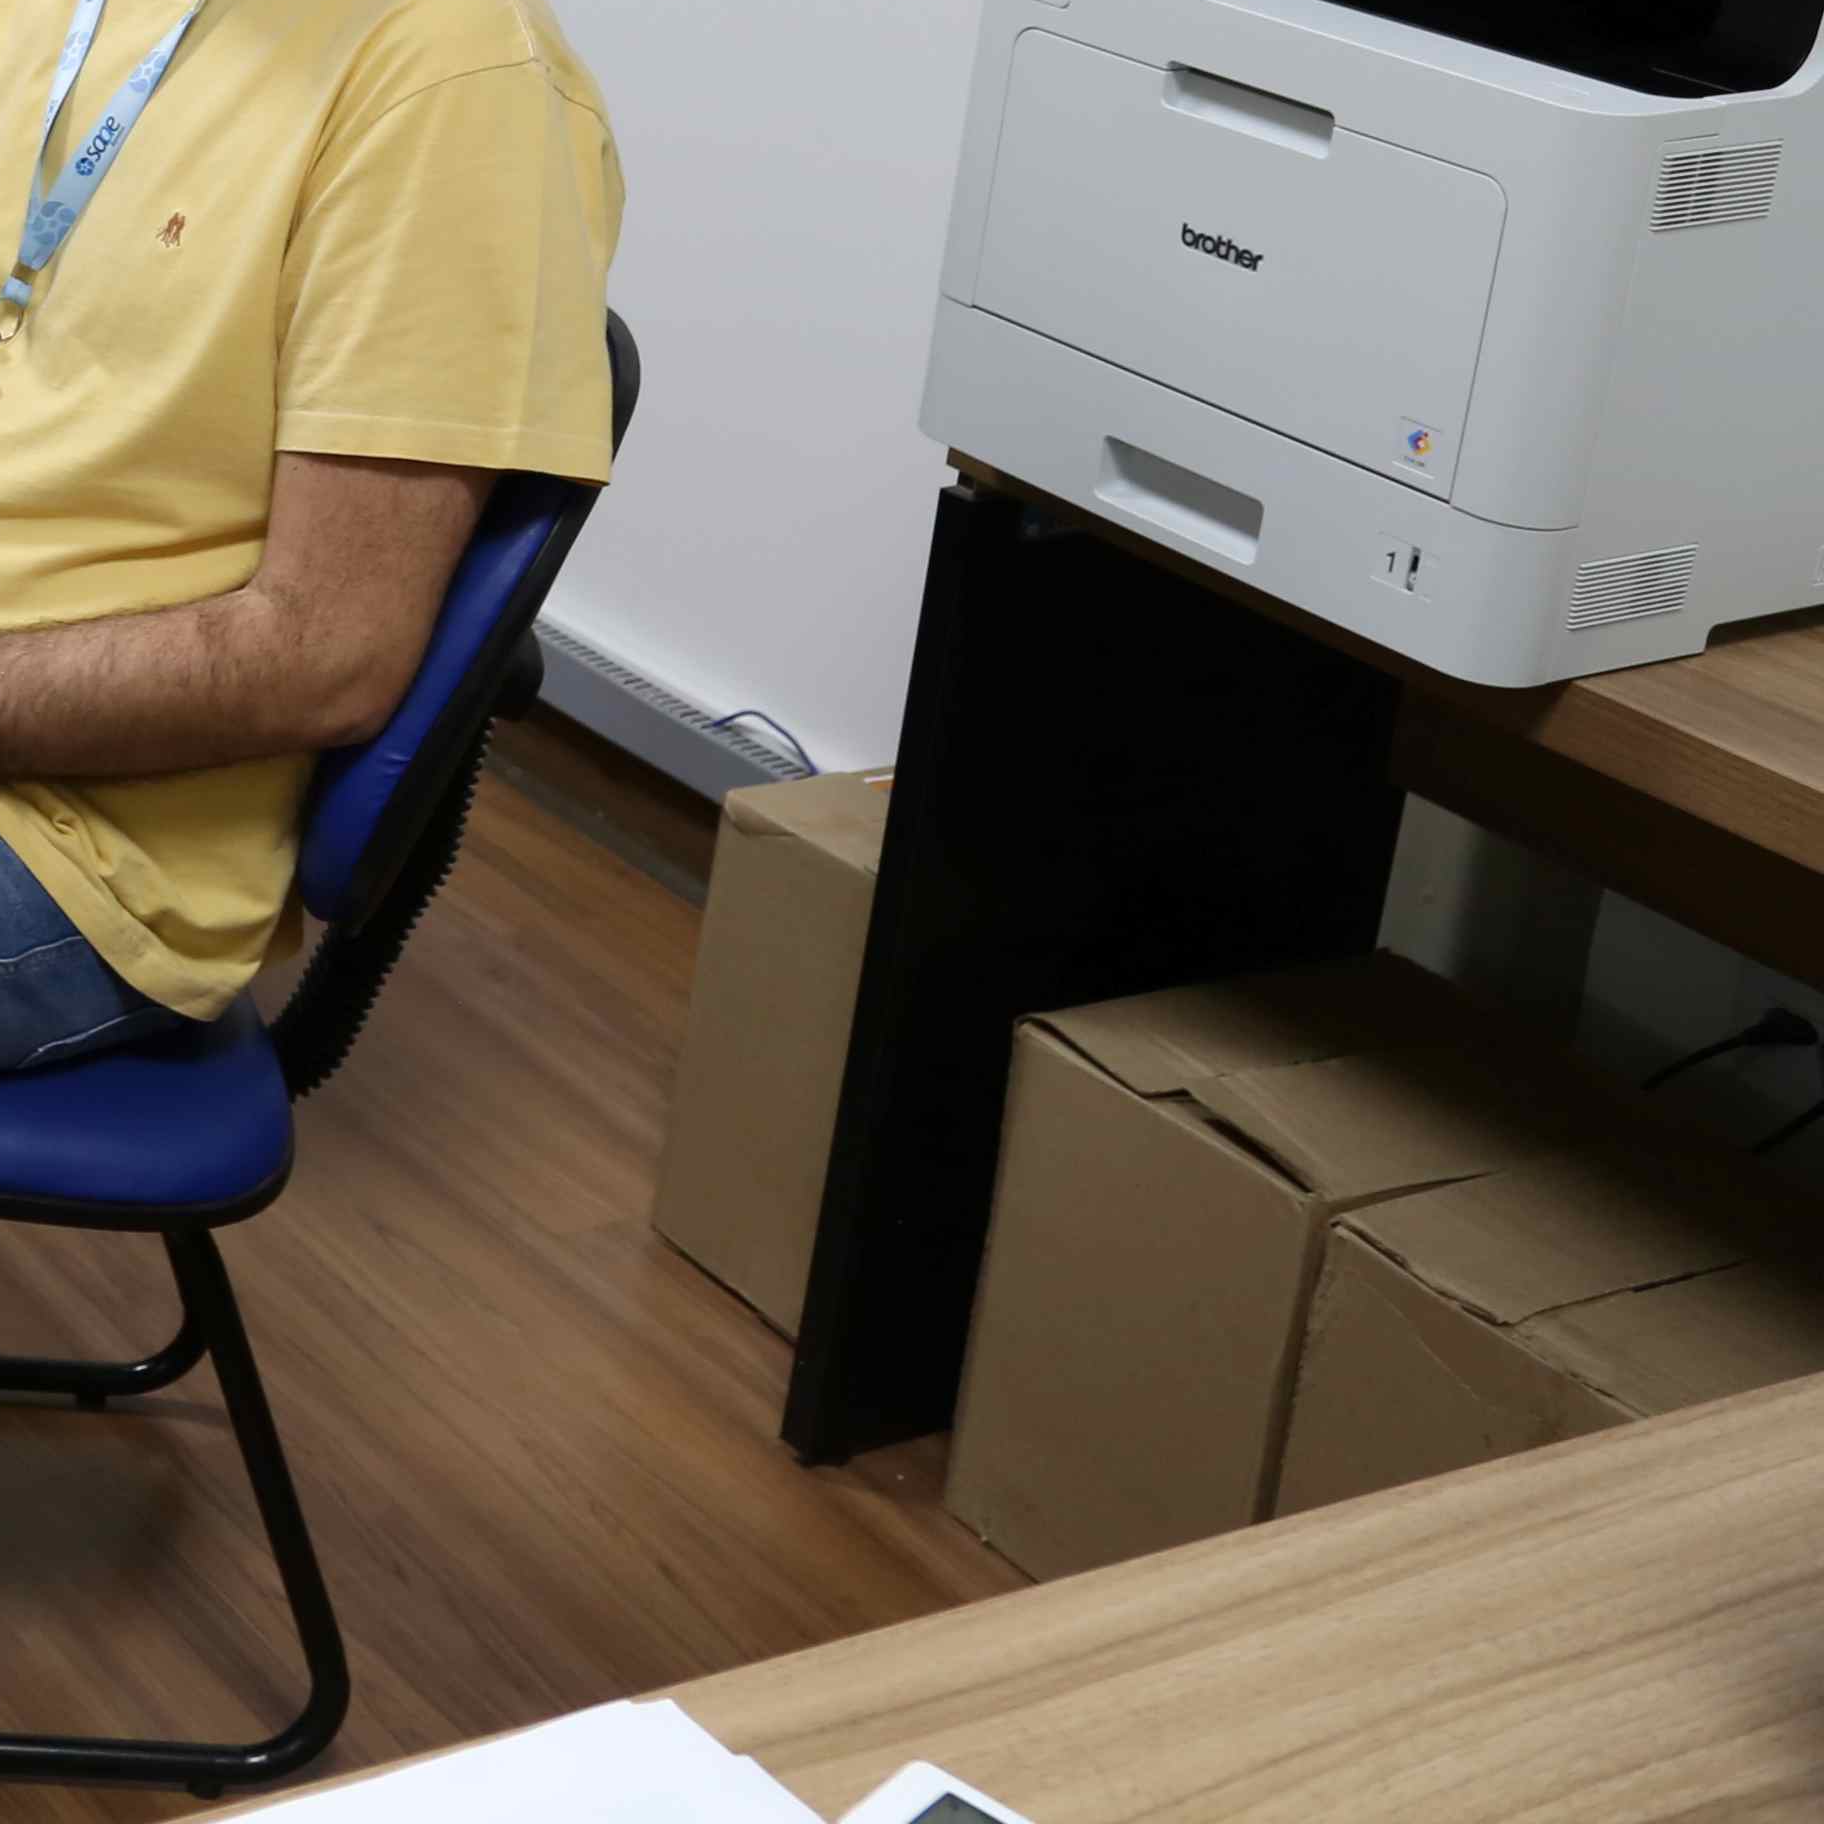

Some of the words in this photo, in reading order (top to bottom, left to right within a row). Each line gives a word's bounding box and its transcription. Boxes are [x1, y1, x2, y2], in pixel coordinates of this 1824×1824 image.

[87, 116, 121, 162] saae
[1181, 222, 1263, 273] brother
[1385, 551, 1397, 574] 1
